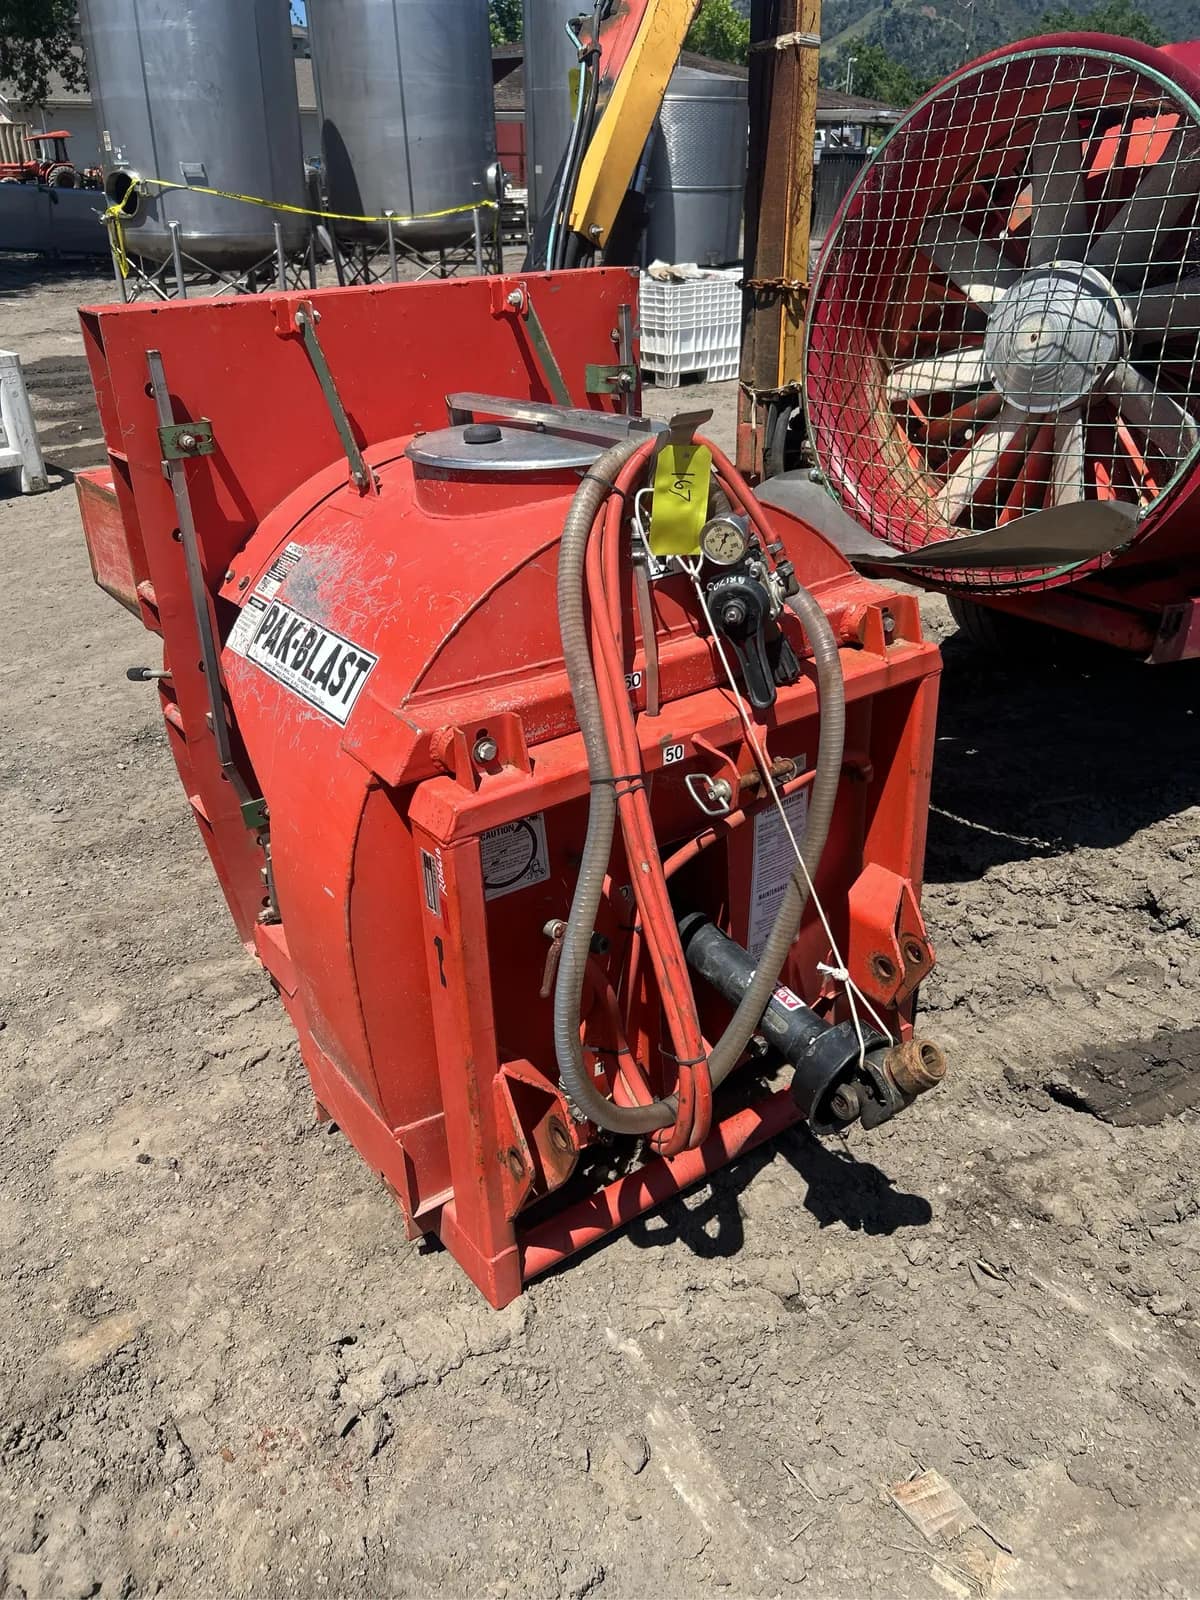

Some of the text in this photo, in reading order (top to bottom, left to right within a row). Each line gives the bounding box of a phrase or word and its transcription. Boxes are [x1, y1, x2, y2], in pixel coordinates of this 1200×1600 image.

[668, 473, 695, 502] 167
[254, 605, 372, 705] PAK-BLAST
[665, 745, 683, 762] 50
[480, 823, 515, 841] CAUTION
